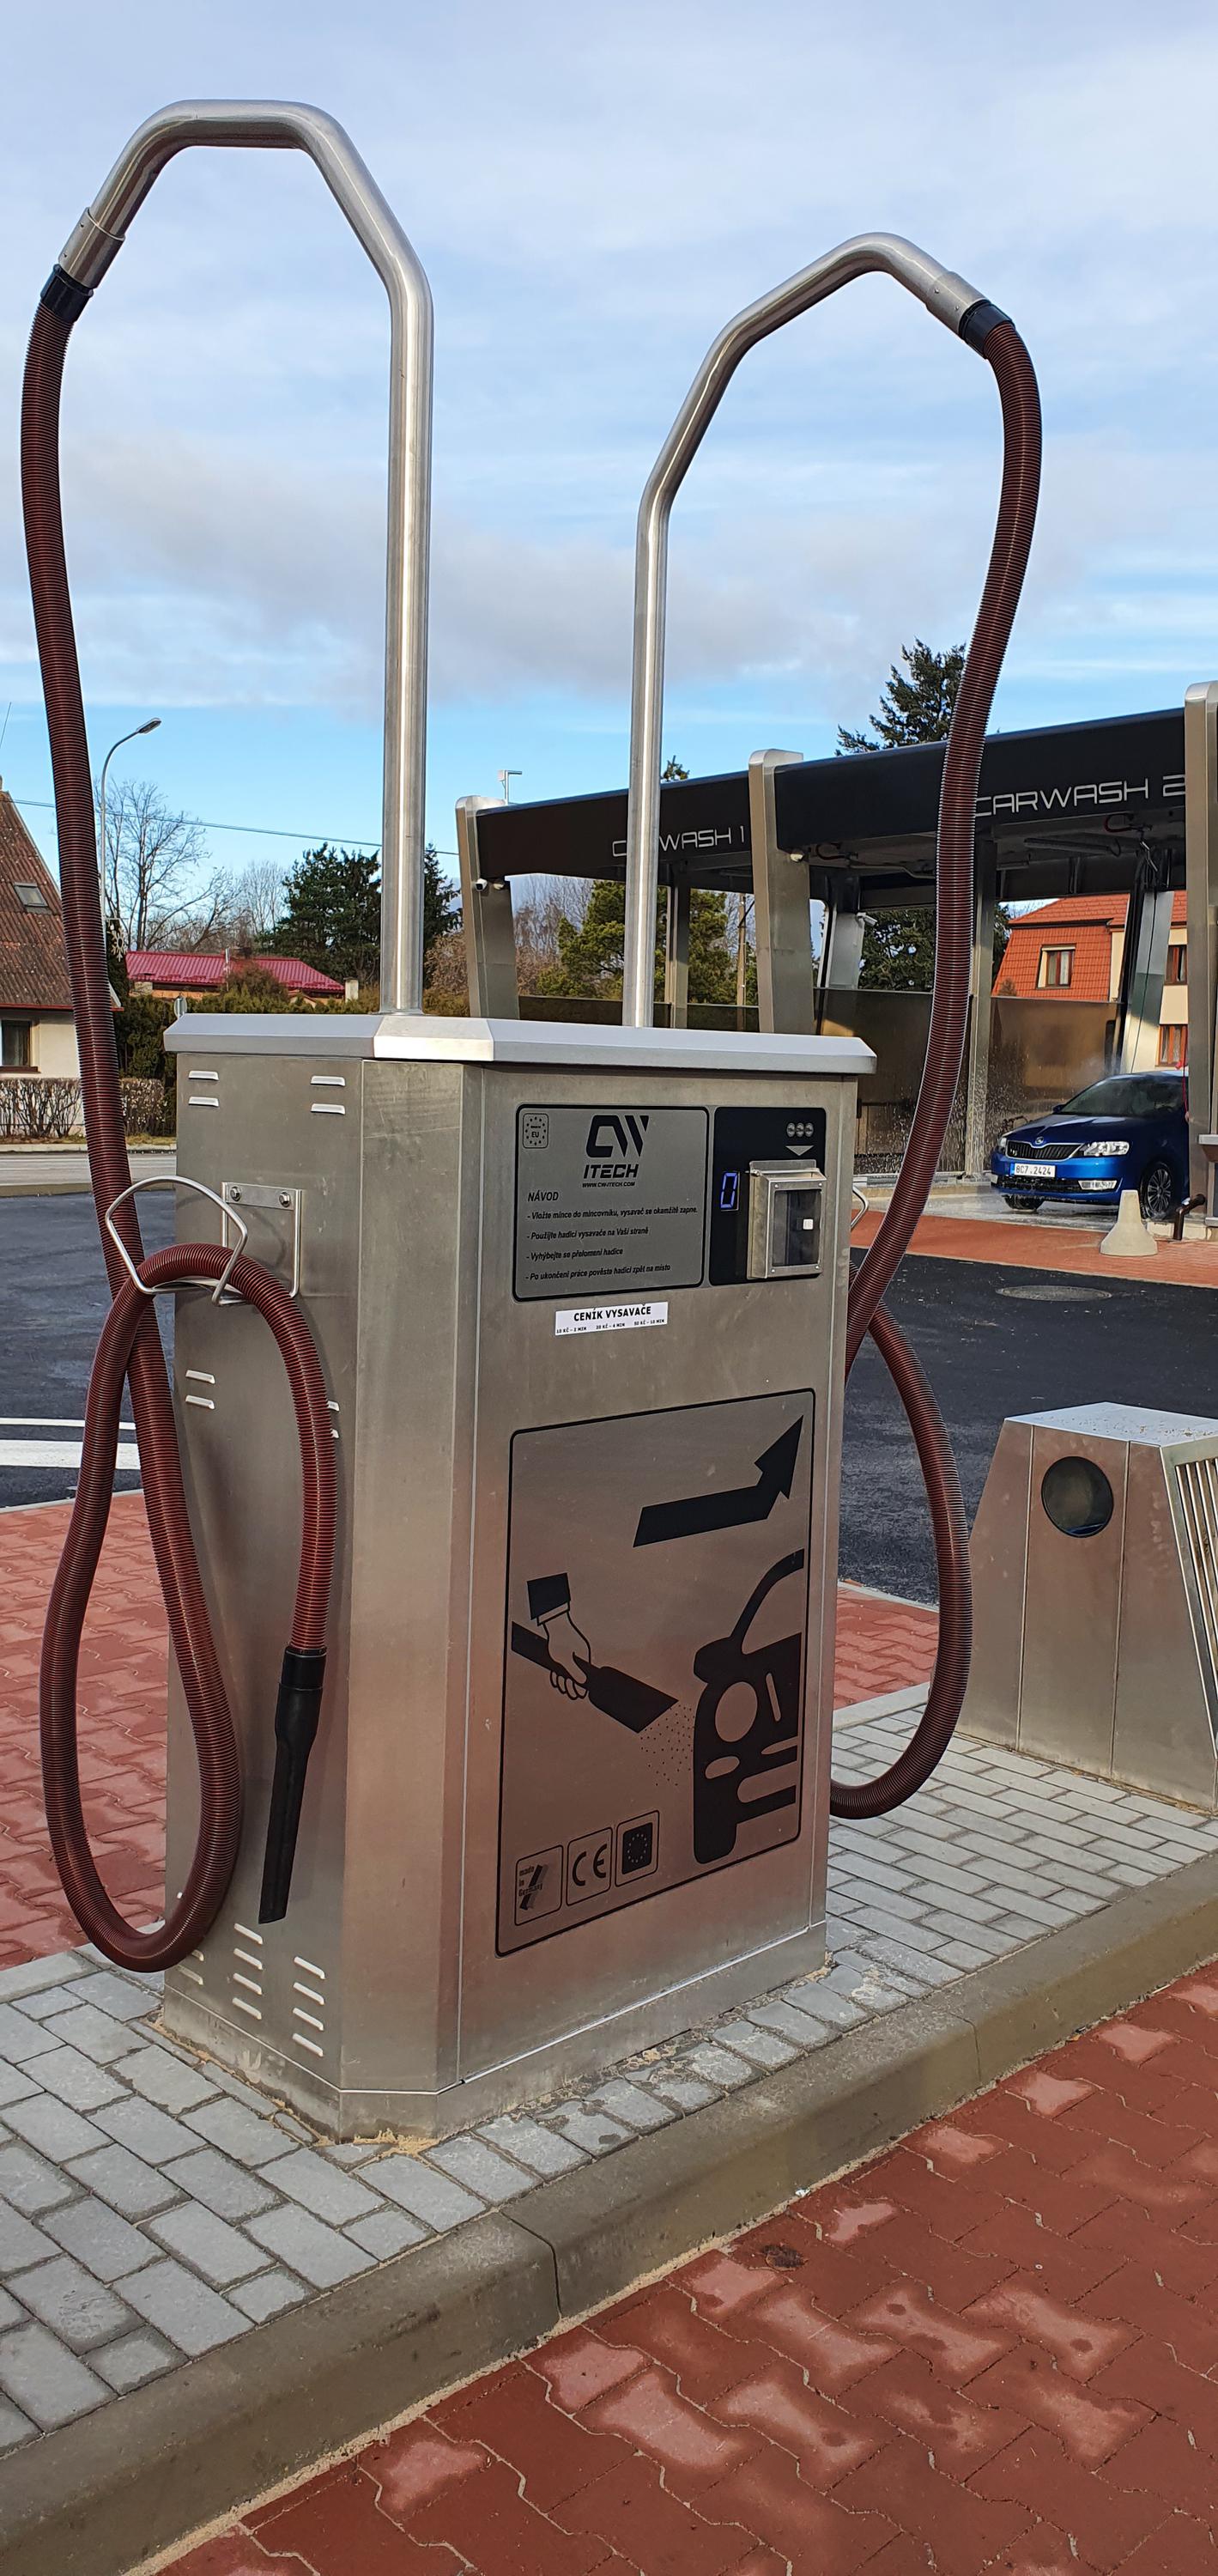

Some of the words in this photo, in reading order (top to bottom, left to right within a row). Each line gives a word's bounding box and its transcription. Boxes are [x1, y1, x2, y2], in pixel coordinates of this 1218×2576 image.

[974, 778, 1149, 817] CARWASH
[1162, 774, 1185, 797] 2
[612, 827, 731, 857] CWASH
[740, 825, 745, 843] 1
[584, 1163, 639, 1179] ITECH
[528, 1189, 560, 1202] NÁVOD
[720, 1172, 738, 1208] 0
[532, 1210, 552, 1219] Vložte
[621, 1207, 644, 1218] vysavač
[653, 1206, 679, 1215] okamžitě
[680, 1206, 698, 1215] zapne.
[530, 1231, 556, 1241] Použijte
[579, 1229, 606, 1239] vysavače
[630, 1226, 649, 1235] straně
[530, 1251, 562, 1261] Vyhýbejte
[572, 1249, 603, 1260] přelomení
[530, 1272, 539, 1280] Po
[540, 1270, 569, 1279] ukončení
[570, 1269, 587, 1279] práce
[588, 1267, 613, 1278] pověste
[633, 1265, 645, 1274] zpět
[573, 1308, 603, 1321] CENÍK
[605, 1303, 651, 1319] VYSAVAČE
[572, 1844, 608, 1886] CE
